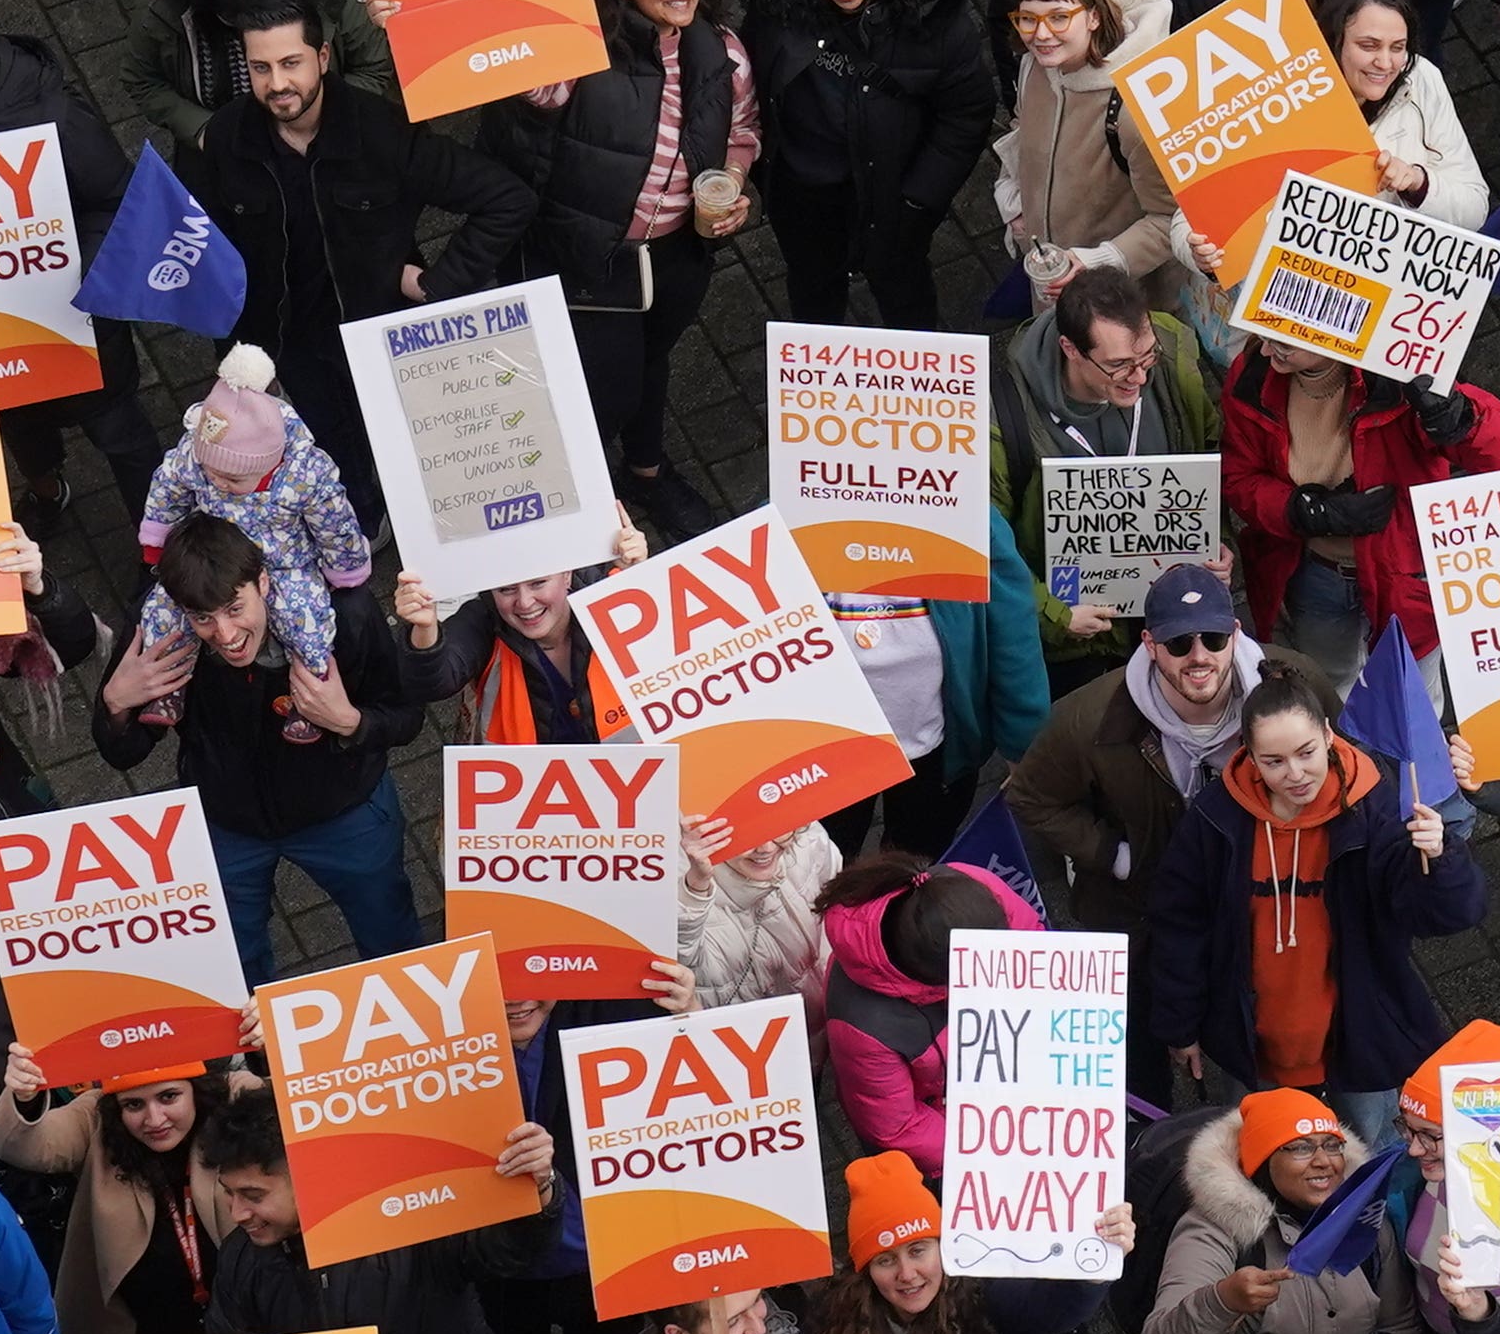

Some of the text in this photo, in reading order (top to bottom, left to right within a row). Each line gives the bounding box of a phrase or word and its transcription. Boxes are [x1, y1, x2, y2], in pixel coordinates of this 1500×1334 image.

[1058, 468, 1180, 489] THERE'S A
[1047, 490, 1146, 511] REASON
[1047, 512, 1203, 533] JUNIOR DR'S
[1062, 532, 1210, 555] ARE LEAVING!
[953, 948, 1126, 995] INADEQUATE
[957, 1008, 1125, 1083] PAY KEEPS
[1050, 1053, 1114, 1087] THE
[958, 1103, 1115, 1159] DOCTOR
